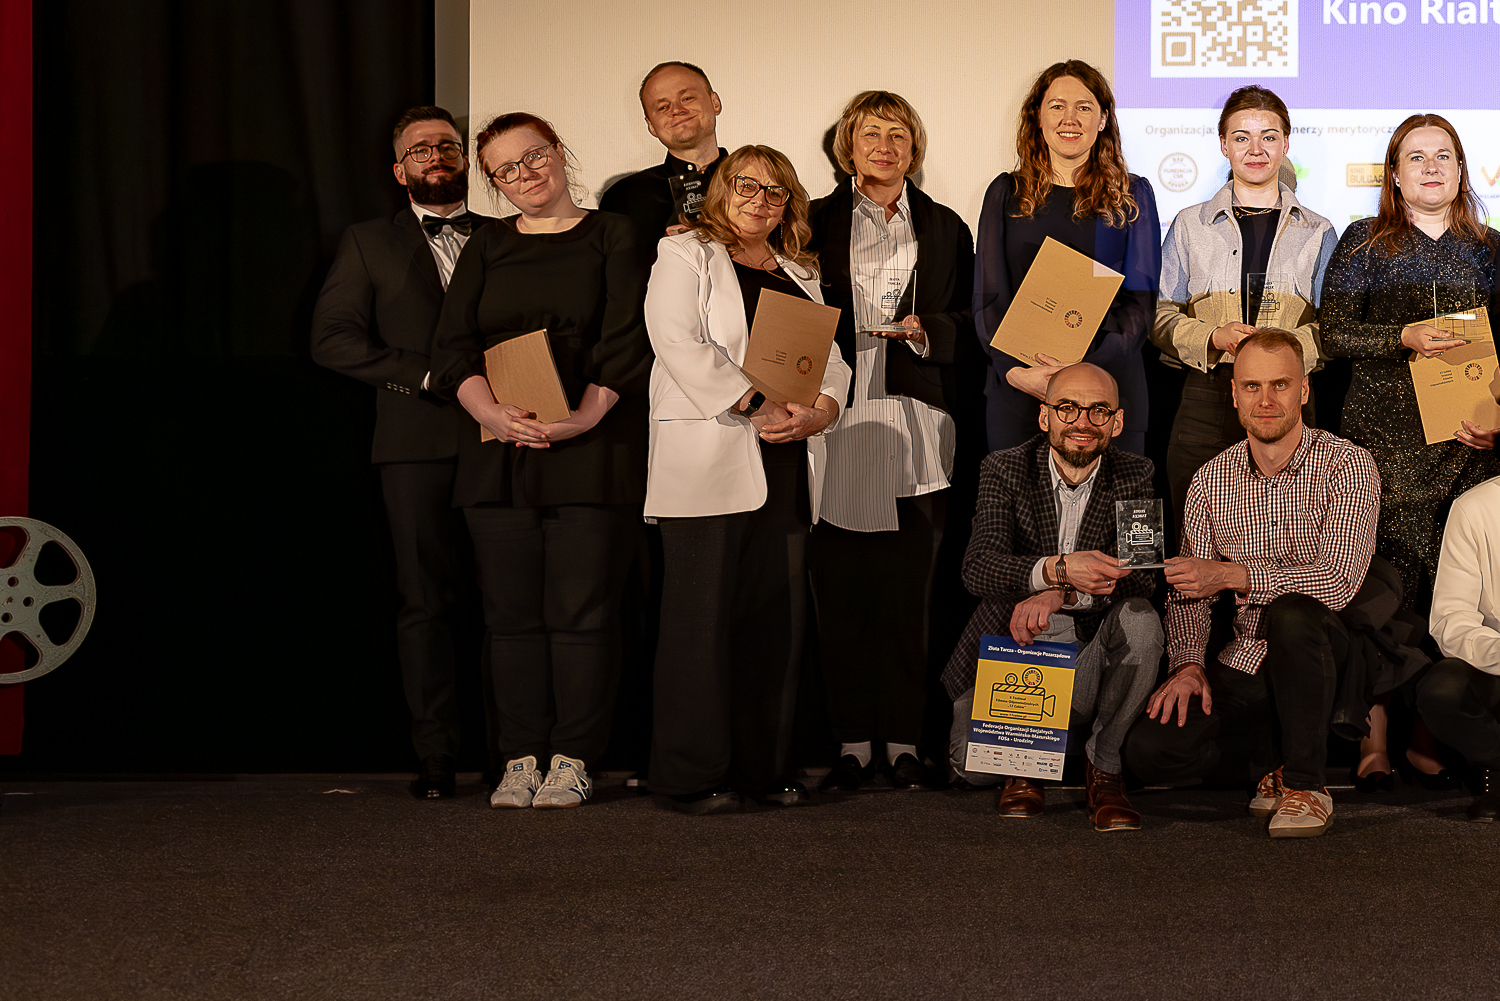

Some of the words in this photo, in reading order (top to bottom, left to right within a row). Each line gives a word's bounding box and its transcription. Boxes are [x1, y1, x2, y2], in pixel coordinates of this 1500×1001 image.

[1145, 125, 1215, 137] Organizacja:
[1292, 126, 1323, 136] nerzy
[1328, 124, 1397, 136] merytorycz
[1017, 648, 1042, 657] Organizacje
[982, 722, 1004, 731] Federacja
[1004, 725, 1029, 733] Organizacji
[1013, 737, 1034, 745] Urodziny
